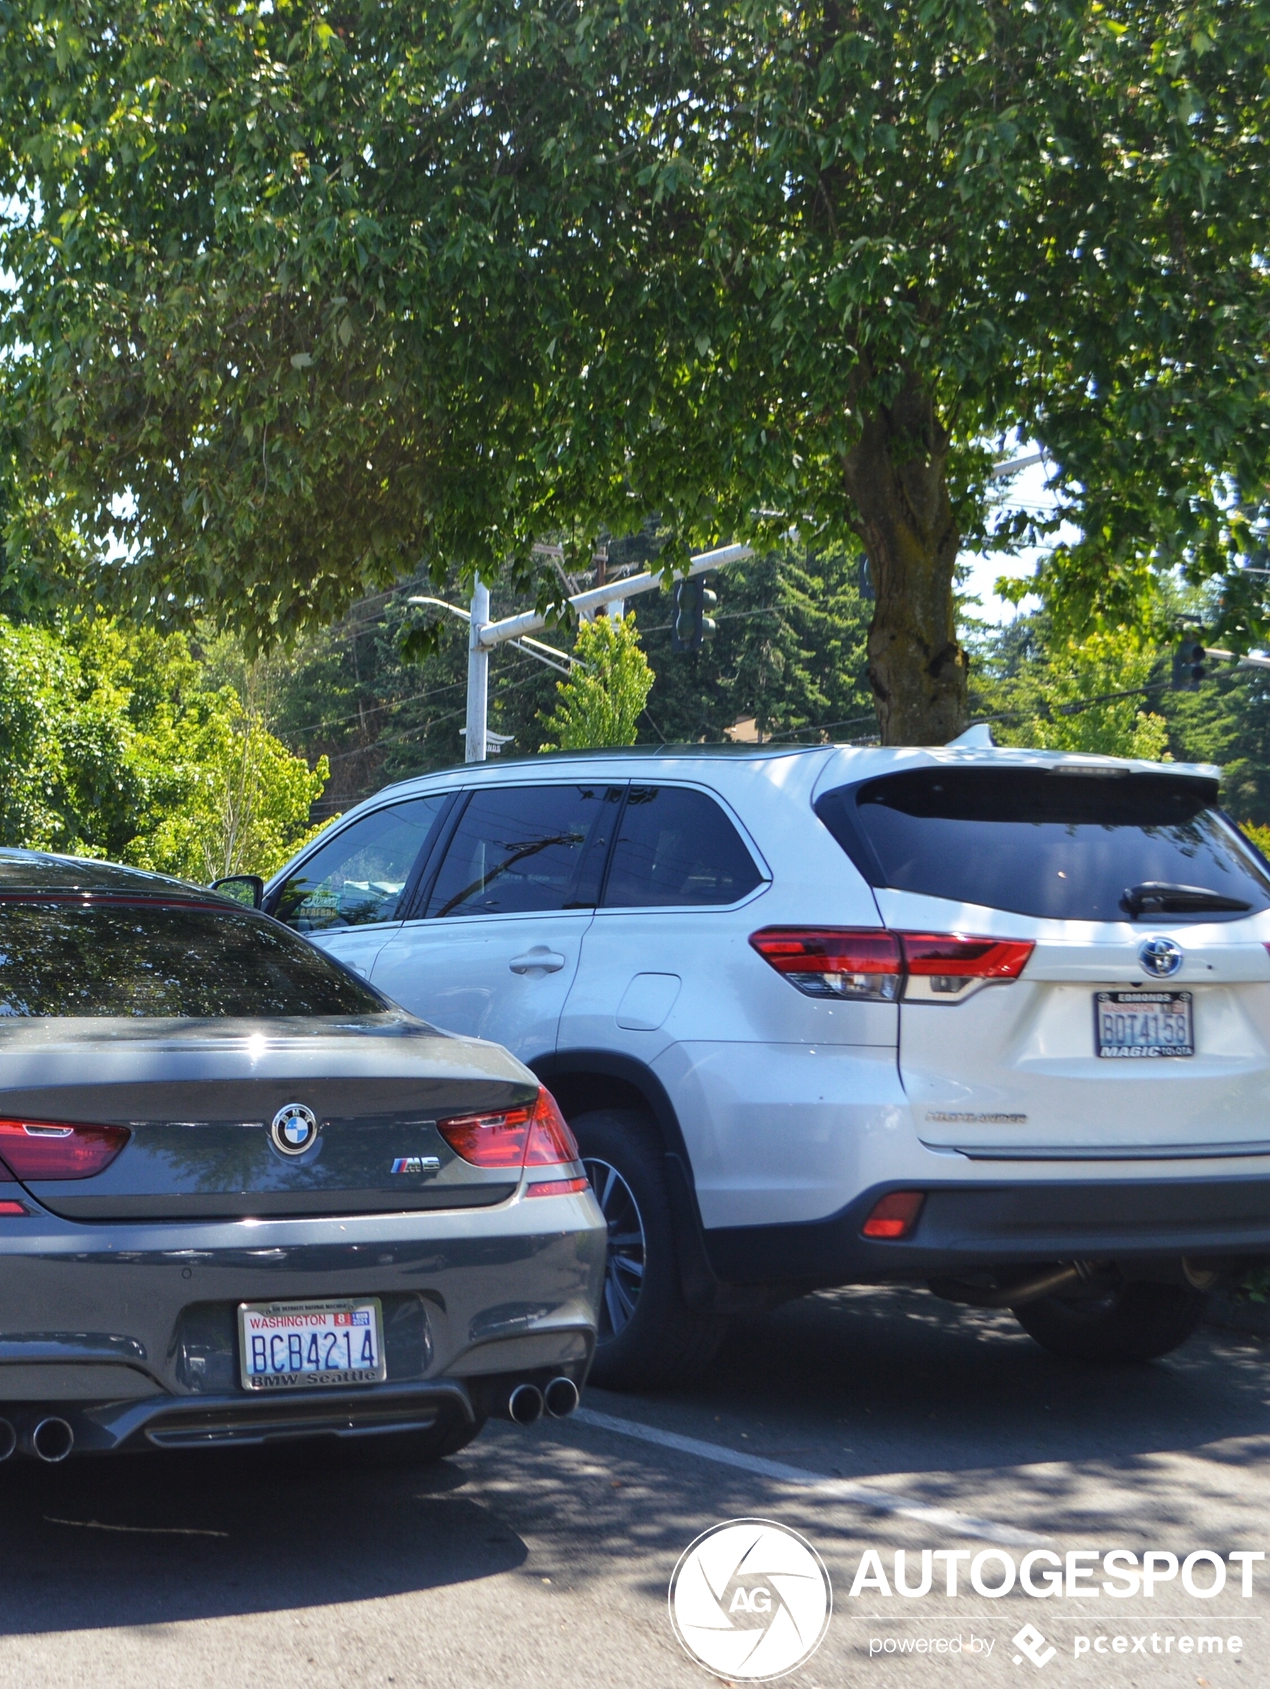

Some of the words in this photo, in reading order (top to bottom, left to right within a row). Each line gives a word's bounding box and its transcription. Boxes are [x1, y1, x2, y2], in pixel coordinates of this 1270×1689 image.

[1118, 993, 1172, 1002] EDMONDS
[1103, 1014, 1186, 1044] BDT4158
[1100, 1046, 1161, 1058] MAGIC
[1160, 1047, 1193, 1056] TOYOTA
[281, 1109, 312, 1123] BMW
[401, 1156, 440, 1172] M6
[250, 1314, 326, 1329] WASHINGTON
[251, 1329, 375, 1374] BCB4214
[251, 1374, 298, 1387] BMW
[306, 1371, 376, 1384] Seattle
